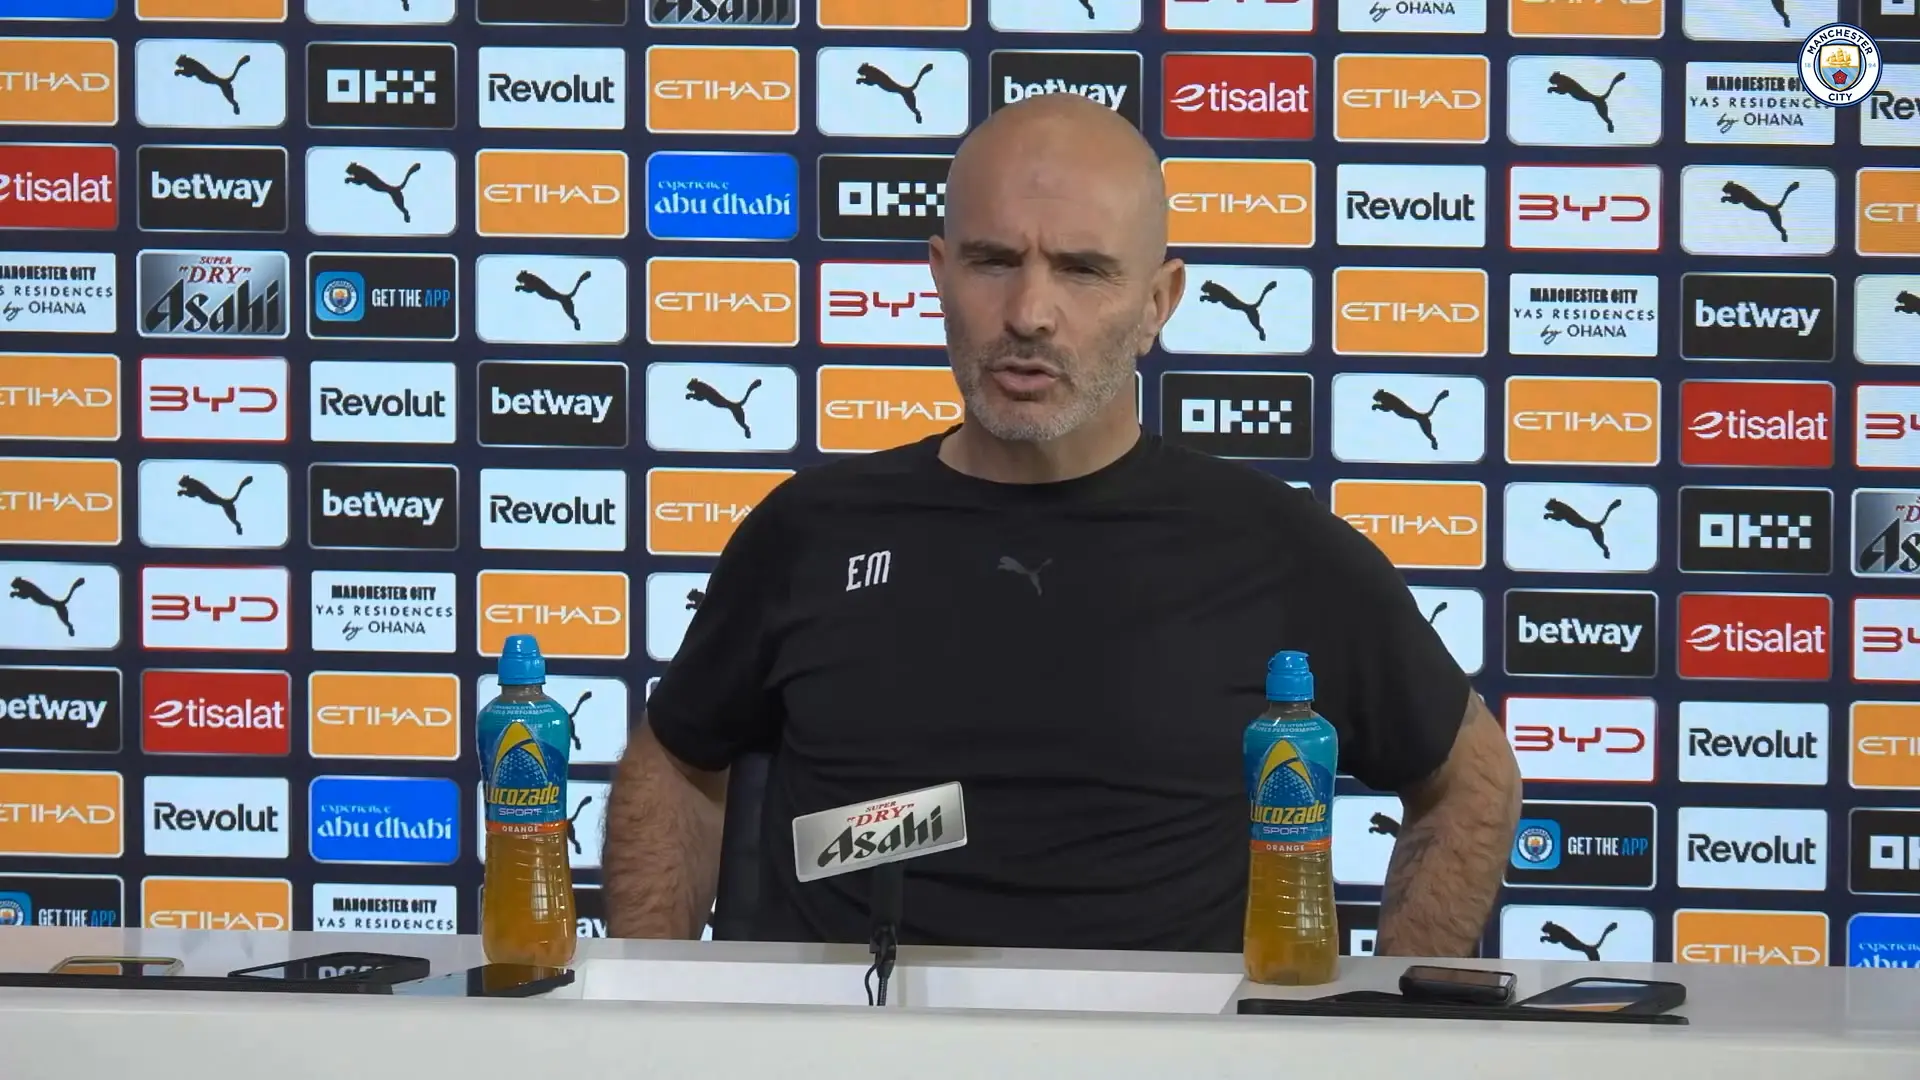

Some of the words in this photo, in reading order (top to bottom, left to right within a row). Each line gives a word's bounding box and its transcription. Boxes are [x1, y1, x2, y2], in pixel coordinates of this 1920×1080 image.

[1396, 0, 1455, 14] OHANA
[0, 72, 110, 92] TIHAD
[327, 69, 436, 104] OKX
[489, 74, 614, 103] Revolut
[654, 80, 791, 101] ETIHAD
[1706, 76, 1786, 91] MANCHESTER
[1170, 82, 1309, 113] etisalat
[1343, 89, 1481, 109] ETIHAD
[1690, 96, 1720, 107] YAS
[1729, 97, 1836, 109] RESIDENCE
[1717, 113, 1739, 134] by
[1744, 113, 1804, 127] OHANA
[152, 171, 272, 207] betway
[484, 184, 620, 205] ETIHAD
[658, 180, 729, 191] experience
[654, 194, 707, 215] abu
[712, 193, 791, 216] dhabi
[1169, 192, 1307, 213] ETIHAD
[1347, 190, 1475, 221] Revolut
[1519, 194, 1651, 222] BYD
[200, 256, 233, 265] SUPER
[0, 265, 67, 280] ANCHESTER
[70, 267, 96, 280] CITY
[14, 285, 113, 297] RESIDENCES
[371, 288, 396, 307] GET
[398, 288, 422, 307] THE
[424, 289, 451, 308] APP
[1530, 288, 1609, 303] MANCHESTER
[1611, 289, 1638, 304] CITY
[3, 301, 24, 322] by
[28, 300, 86, 314] OHANA
[145, 279, 281, 333] Asahi
[654, 291, 791, 313] ETIHAD
[1341, 302, 1479, 322] ETIHAD
[1514, 307, 1546, 319] YAS
[1552, 308, 1655, 321] RESIDENCES
[1695, 299, 1820, 336] betway
[1541, 325, 1562, 345] by
[1567, 324, 1627, 338] OHANA
[0, 386, 112, 407] TIHAD
[150, 386, 278, 412] BYD
[320, 387, 446, 417] Revolut
[491, 386, 612, 423] betway
[825, 400, 962, 420] ETIHAD
[1181, 398, 1292, 434] OKX
[1513, 411, 1652, 432] ETIHAD
[1688, 409, 1828, 441] etisalat
[0, 491, 113, 512] TIHAD
[323, 489, 444, 525] betway
[490, 494, 616, 525] Revolut
[655, 502, 752, 522] ETIHA
[1700, 513, 1811, 549] OKX
[846, 550, 892, 592] EM
[331, 585, 407, 600] MANCHESTER
[410, 585, 436, 600] CITY
[151, 595, 279, 621] BYD
[316, 605, 344, 617] YAS
[354, 605, 453, 617] RESIDENCES
[485, 604, 621, 625] ETIHAD
[342, 621, 364, 640] by
[368, 620, 426, 634] OHANA
[1518, 615, 1642, 652] betway
[1685, 621, 1825, 653] etisalat
[149, 699, 285, 729] etisalat
[317, 706, 452, 727] ETIHAD
[1514, 726, 1645, 753] BYD
[1689, 728, 1818, 758] Revolut
[487, 782, 559, 806] ucozade
[154, 802, 278, 832] Revolut
[499, 808, 542, 816] SPORT
[865, 801, 897, 813] SUPER
[318, 815, 369, 838] abu
[375, 815, 452, 840] dhabi
[817, 805, 943, 868] Asahi
[1263, 827, 1308, 836] SPORT
[1266, 844, 1305, 852] ORANGE
[1567, 836, 1594, 856] GET
[1594, 837, 1619, 856] THE
[1622, 838, 1649, 856] APP
[1688, 833, 1816, 864] Revolut
[333, 897, 408, 912] MANCHESTER
[411, 899, 437, 914] CITY
[38, 909, 63, 927] GET
[64, 910, 88, 928] THE
[150, 911, 285, 931] ETIHAD
[317, 917, 346, 929] YAS
[355, 917, 454, 931] RESIDENCES
[1682, 943, 1821, 965] ETIHAD
